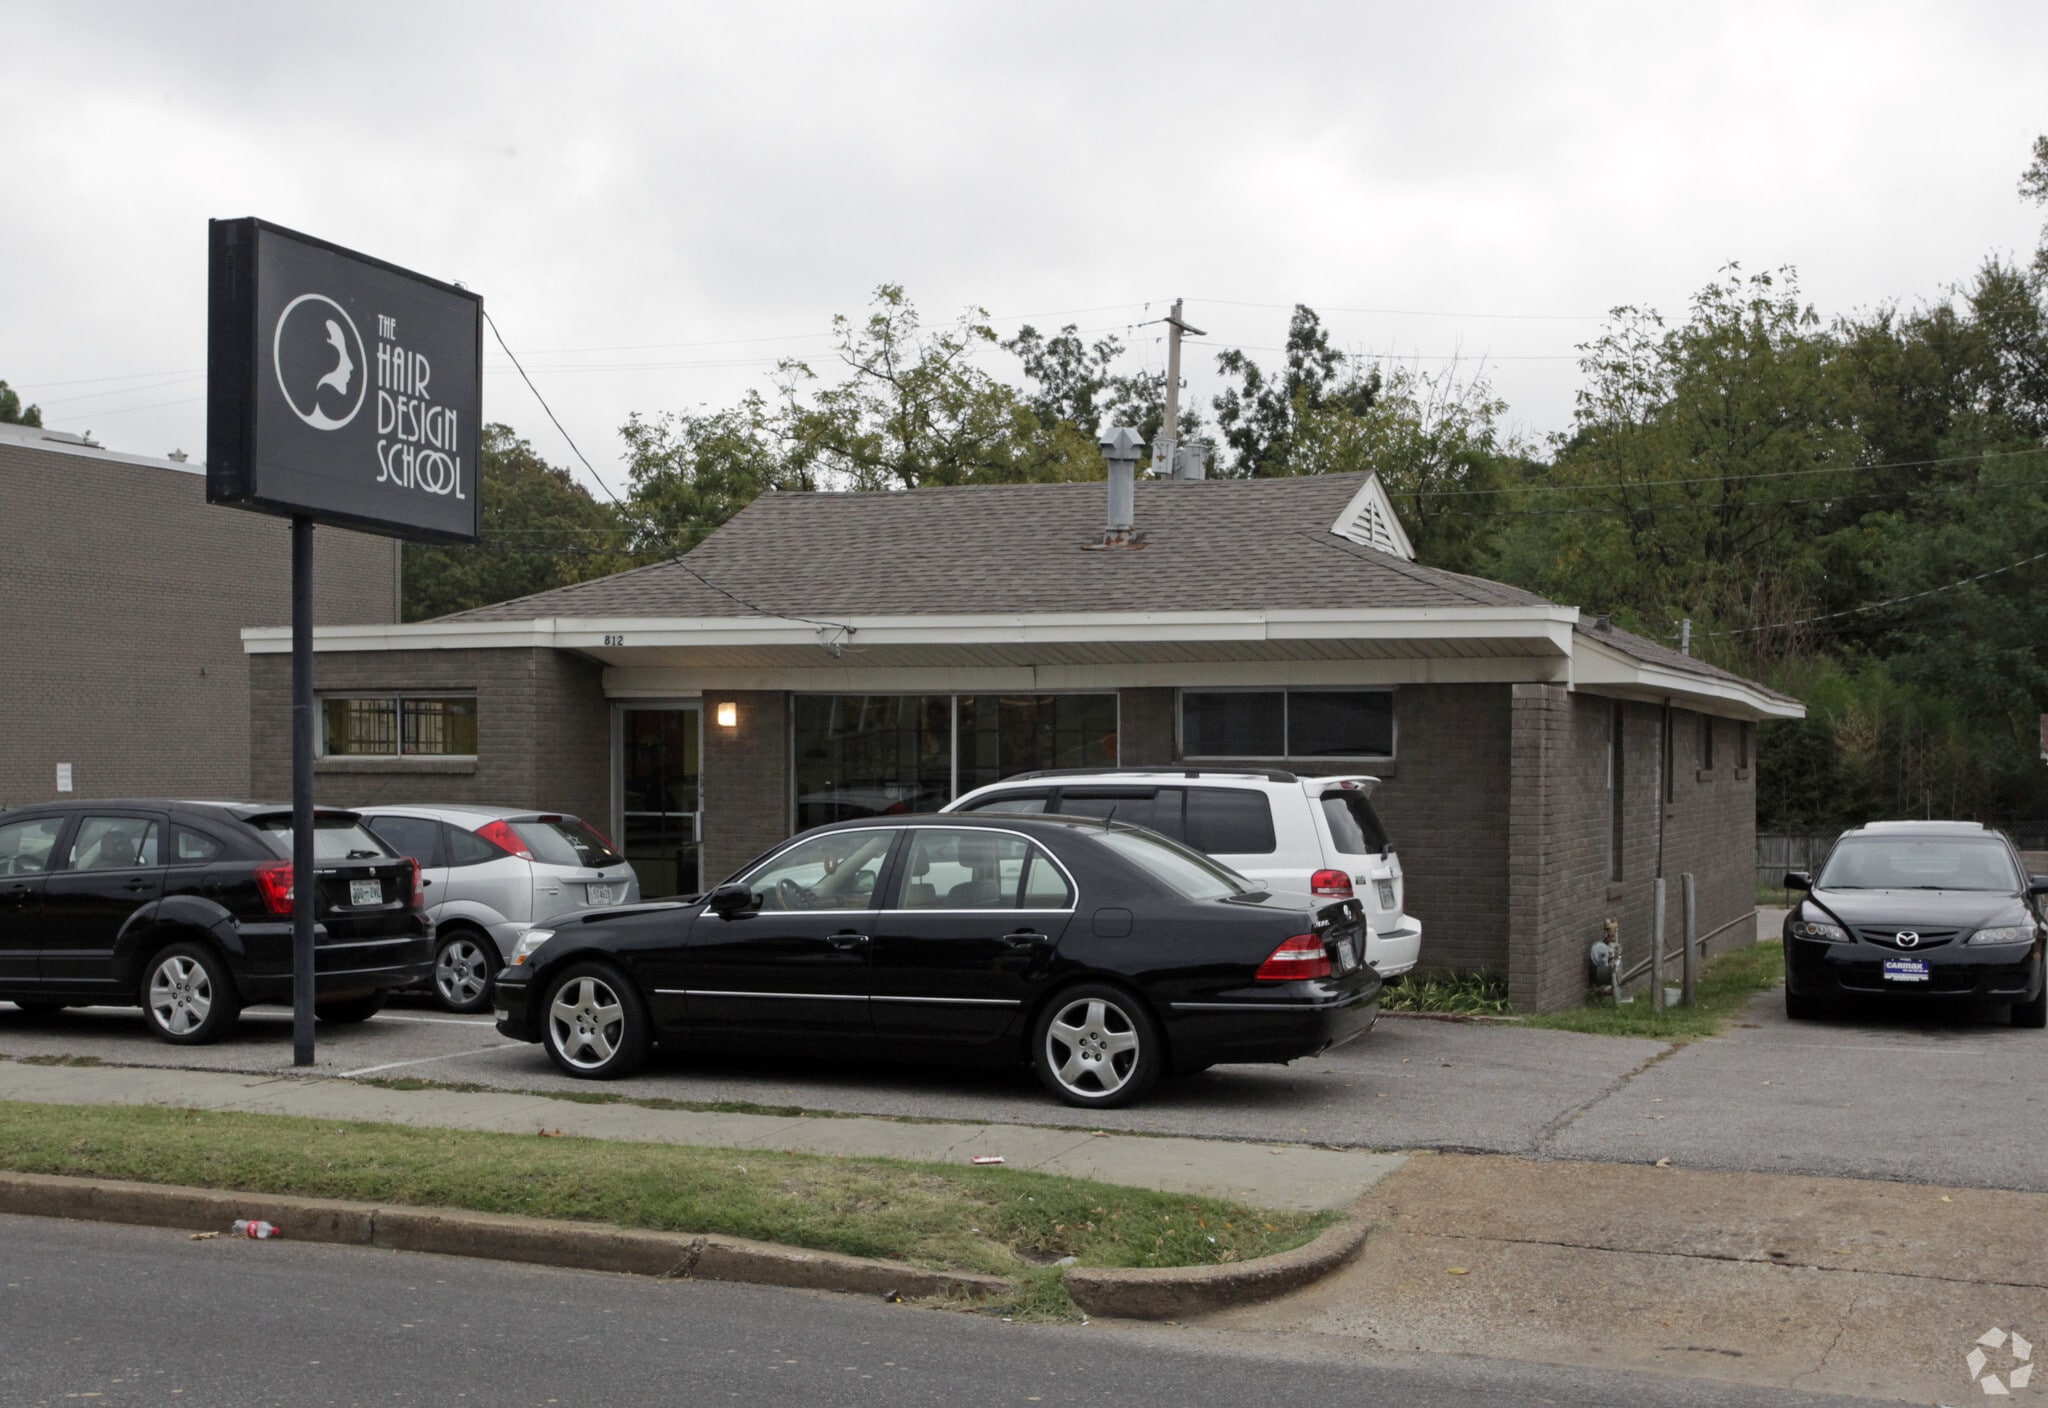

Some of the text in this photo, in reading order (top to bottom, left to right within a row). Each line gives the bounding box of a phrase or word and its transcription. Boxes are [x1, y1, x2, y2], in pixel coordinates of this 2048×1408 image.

[378, 314, 396, 341] THE
[377, 342, 430, 399] HAIR
[377, 389, 457, 451] DESIGN
[376, 439, 465, 500] SCHOOL
[604, 635, 624, 646] 812
